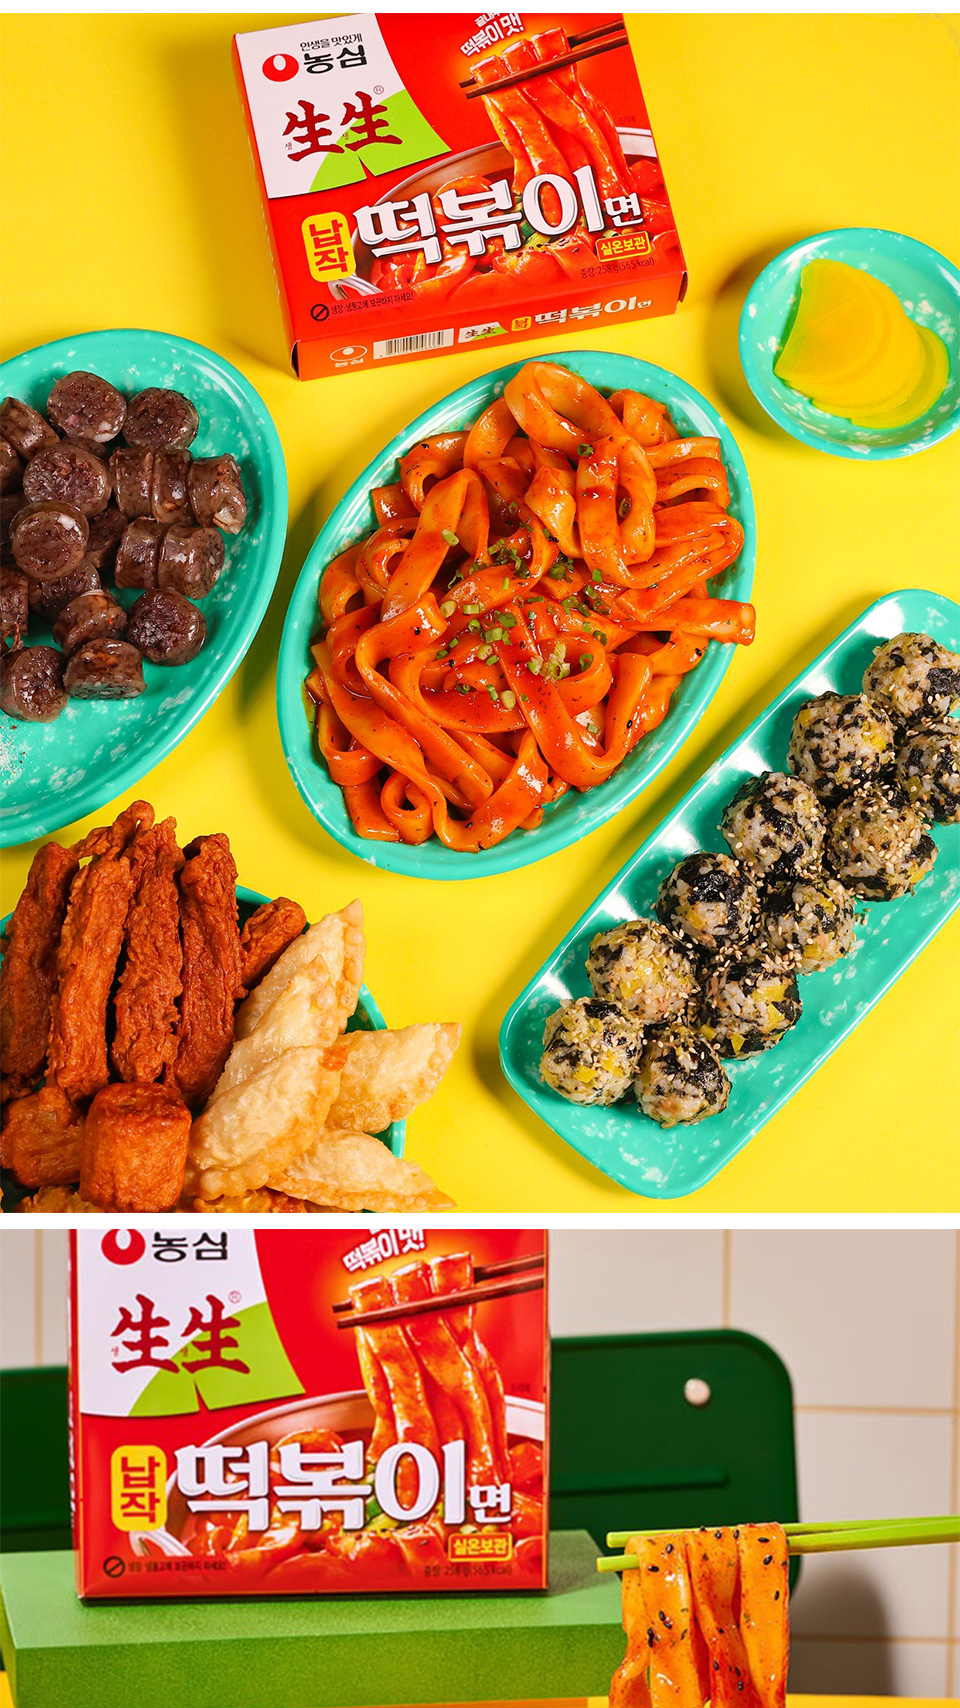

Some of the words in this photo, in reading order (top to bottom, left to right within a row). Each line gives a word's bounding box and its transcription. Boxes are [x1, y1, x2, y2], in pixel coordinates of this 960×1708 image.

[300, 38, 332, 52] 인생을
[331, 32, 364, 46] 맛있게
[460, 20, 505, 57] 떡볶이
[303, 44, 368, 75] 농심
[282, 90, 403, 162] 生生
[308, 219, 349, 273] 납작
[600, 236, 646, 257] 실온보관
[370, 296, 393, 308] 보관하지
[394, 291, 414, 303] 마세요!
[152, 1231, 228, 1263] 농심
[342, 1229, 400, 1273] 떡볶이
[110, 1293, 251, 1374] 生生
[120, 1456, 161, 1524] 납작
[453, 1537, 508, 1556] 실온보관
